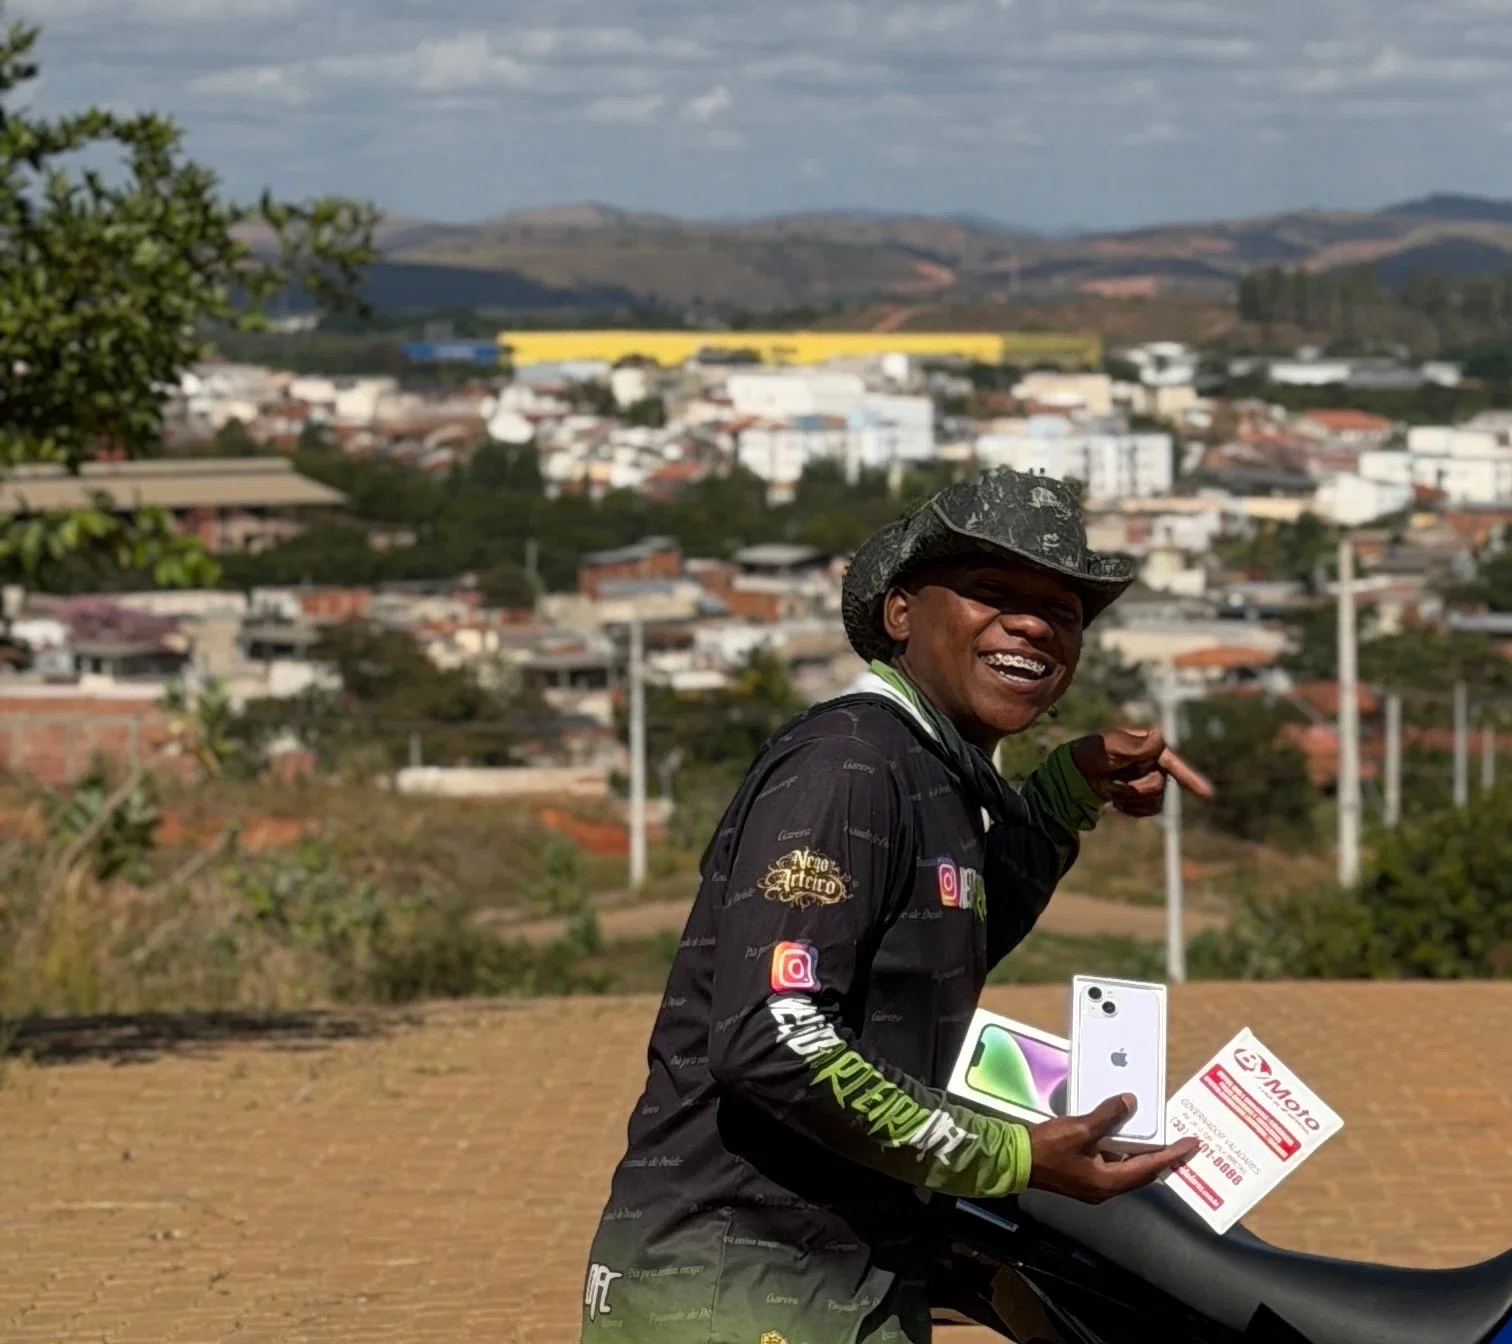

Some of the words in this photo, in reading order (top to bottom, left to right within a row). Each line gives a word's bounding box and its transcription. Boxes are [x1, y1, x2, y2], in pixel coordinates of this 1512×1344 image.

[791, 847, 830, 873] Nego
[775, 868, 836, 896] Arteiro
[1263, 1078, 1321, 1132] Moto
